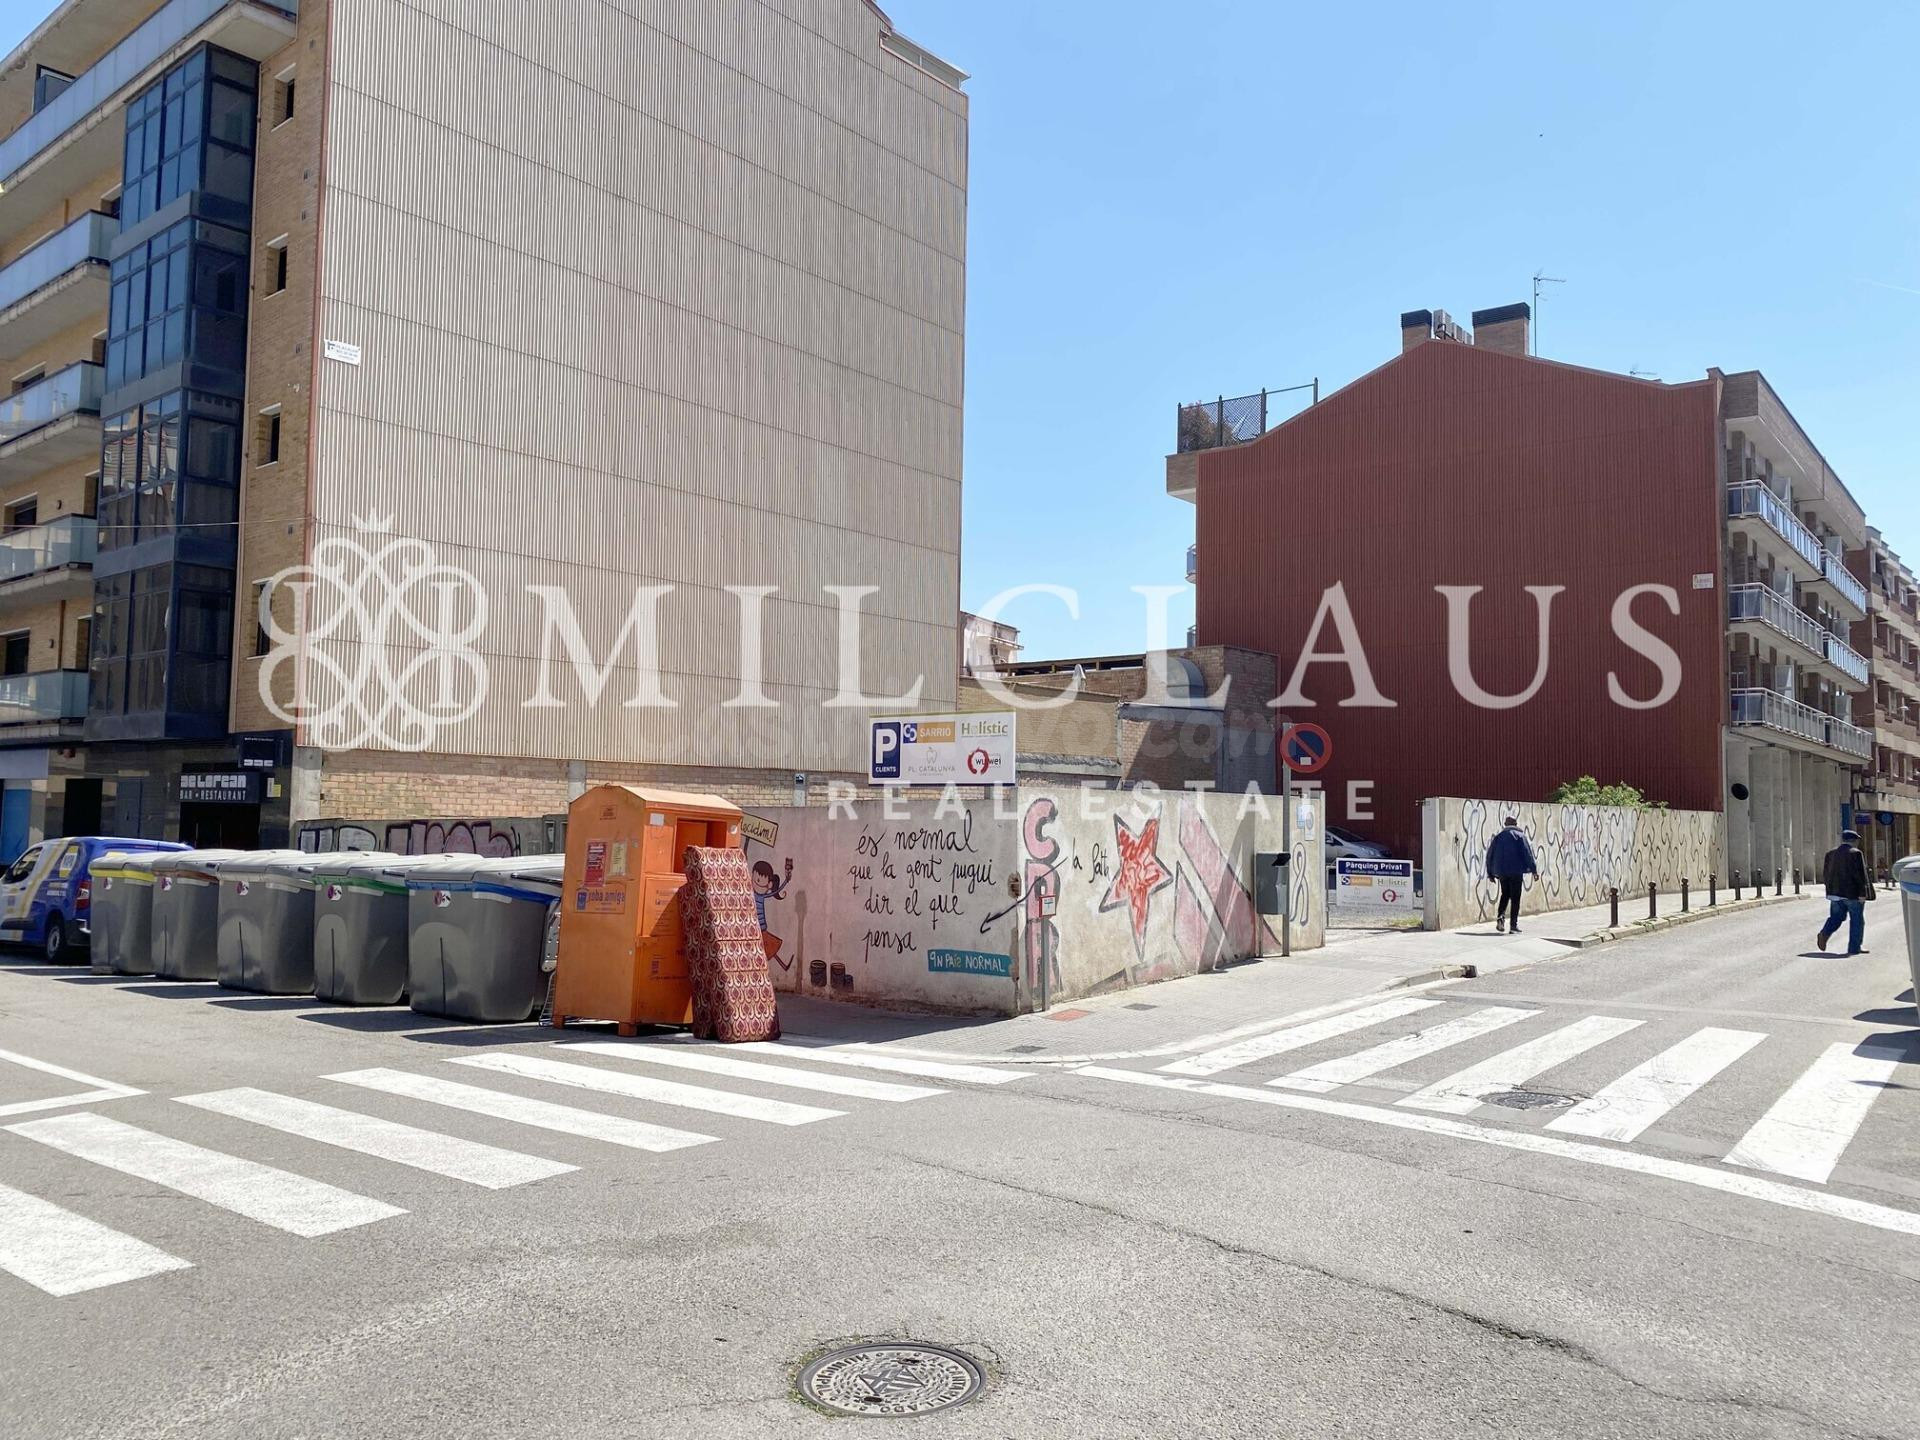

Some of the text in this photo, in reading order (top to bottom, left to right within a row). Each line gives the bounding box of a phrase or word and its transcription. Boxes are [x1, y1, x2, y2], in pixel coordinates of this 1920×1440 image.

[876, 728, 897, 764] P
[918, 765, 955, 773] CATALUNYA
[201, 790, 246, 801] RESTAURANT
[855, 809, 979, 857] és normal
[848, 851, 997, 894] que la gent pugui
[864, 887, 965, 931] dir el que
[862, 929, 917, 963] pensa
[965, 954, 1006, 973] NORMAL
